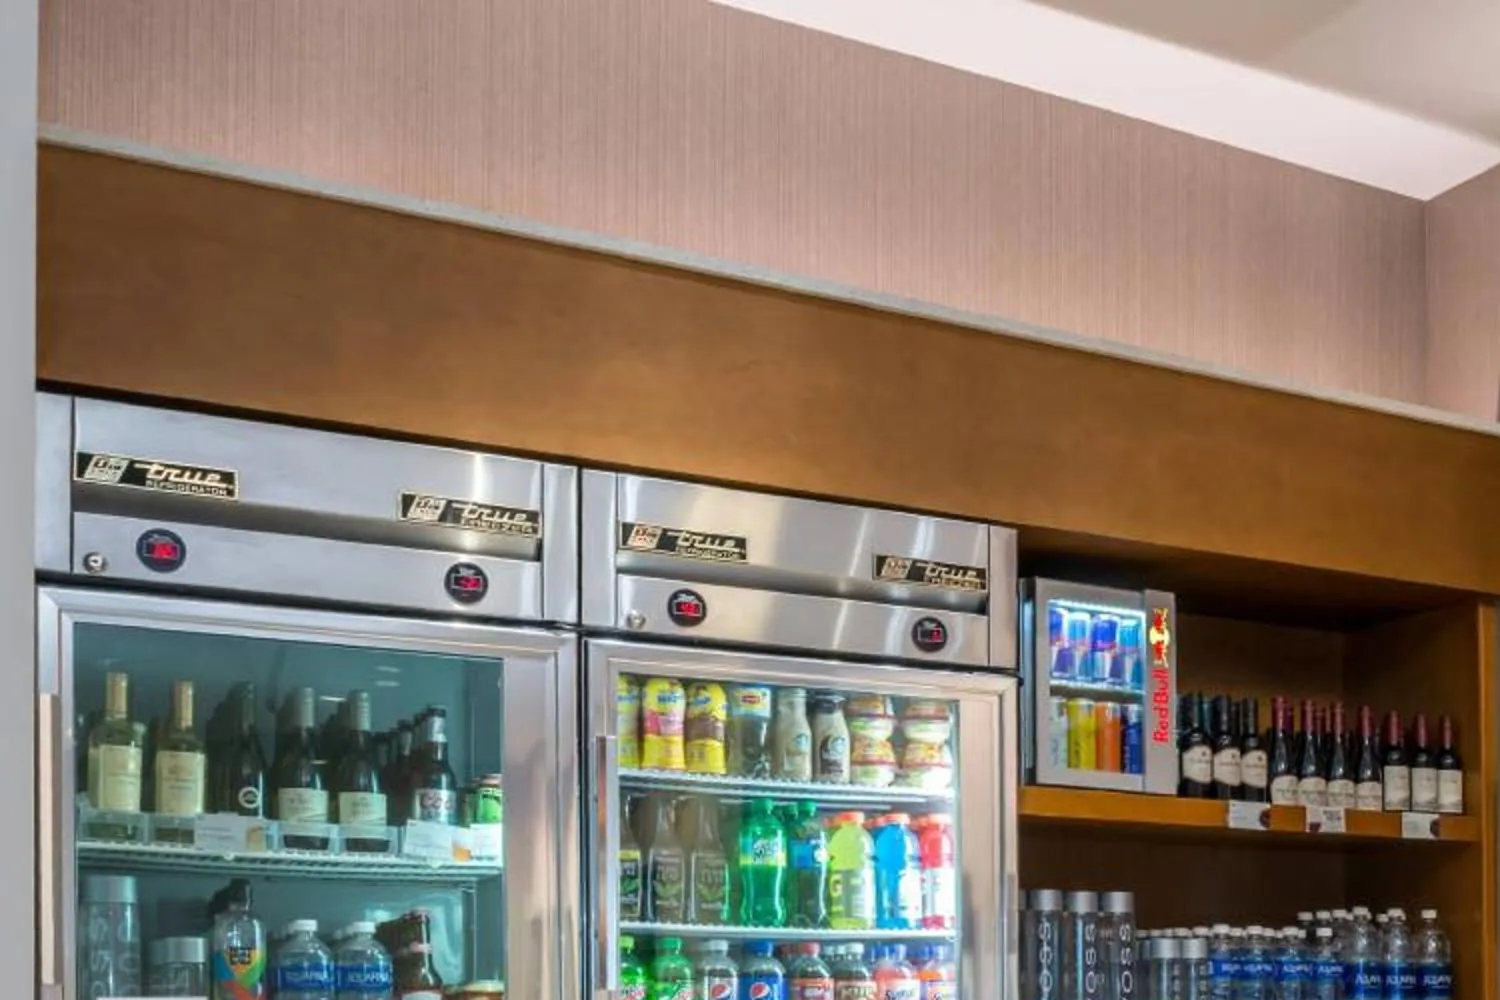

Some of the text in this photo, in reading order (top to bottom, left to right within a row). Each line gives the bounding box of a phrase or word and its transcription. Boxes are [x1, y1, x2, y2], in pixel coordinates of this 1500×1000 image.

[134, 463, 228, 488] true
[452, 503, 533, 525] true
[666, 531, 741, 552] true
[916, 562, 981, 582] true
